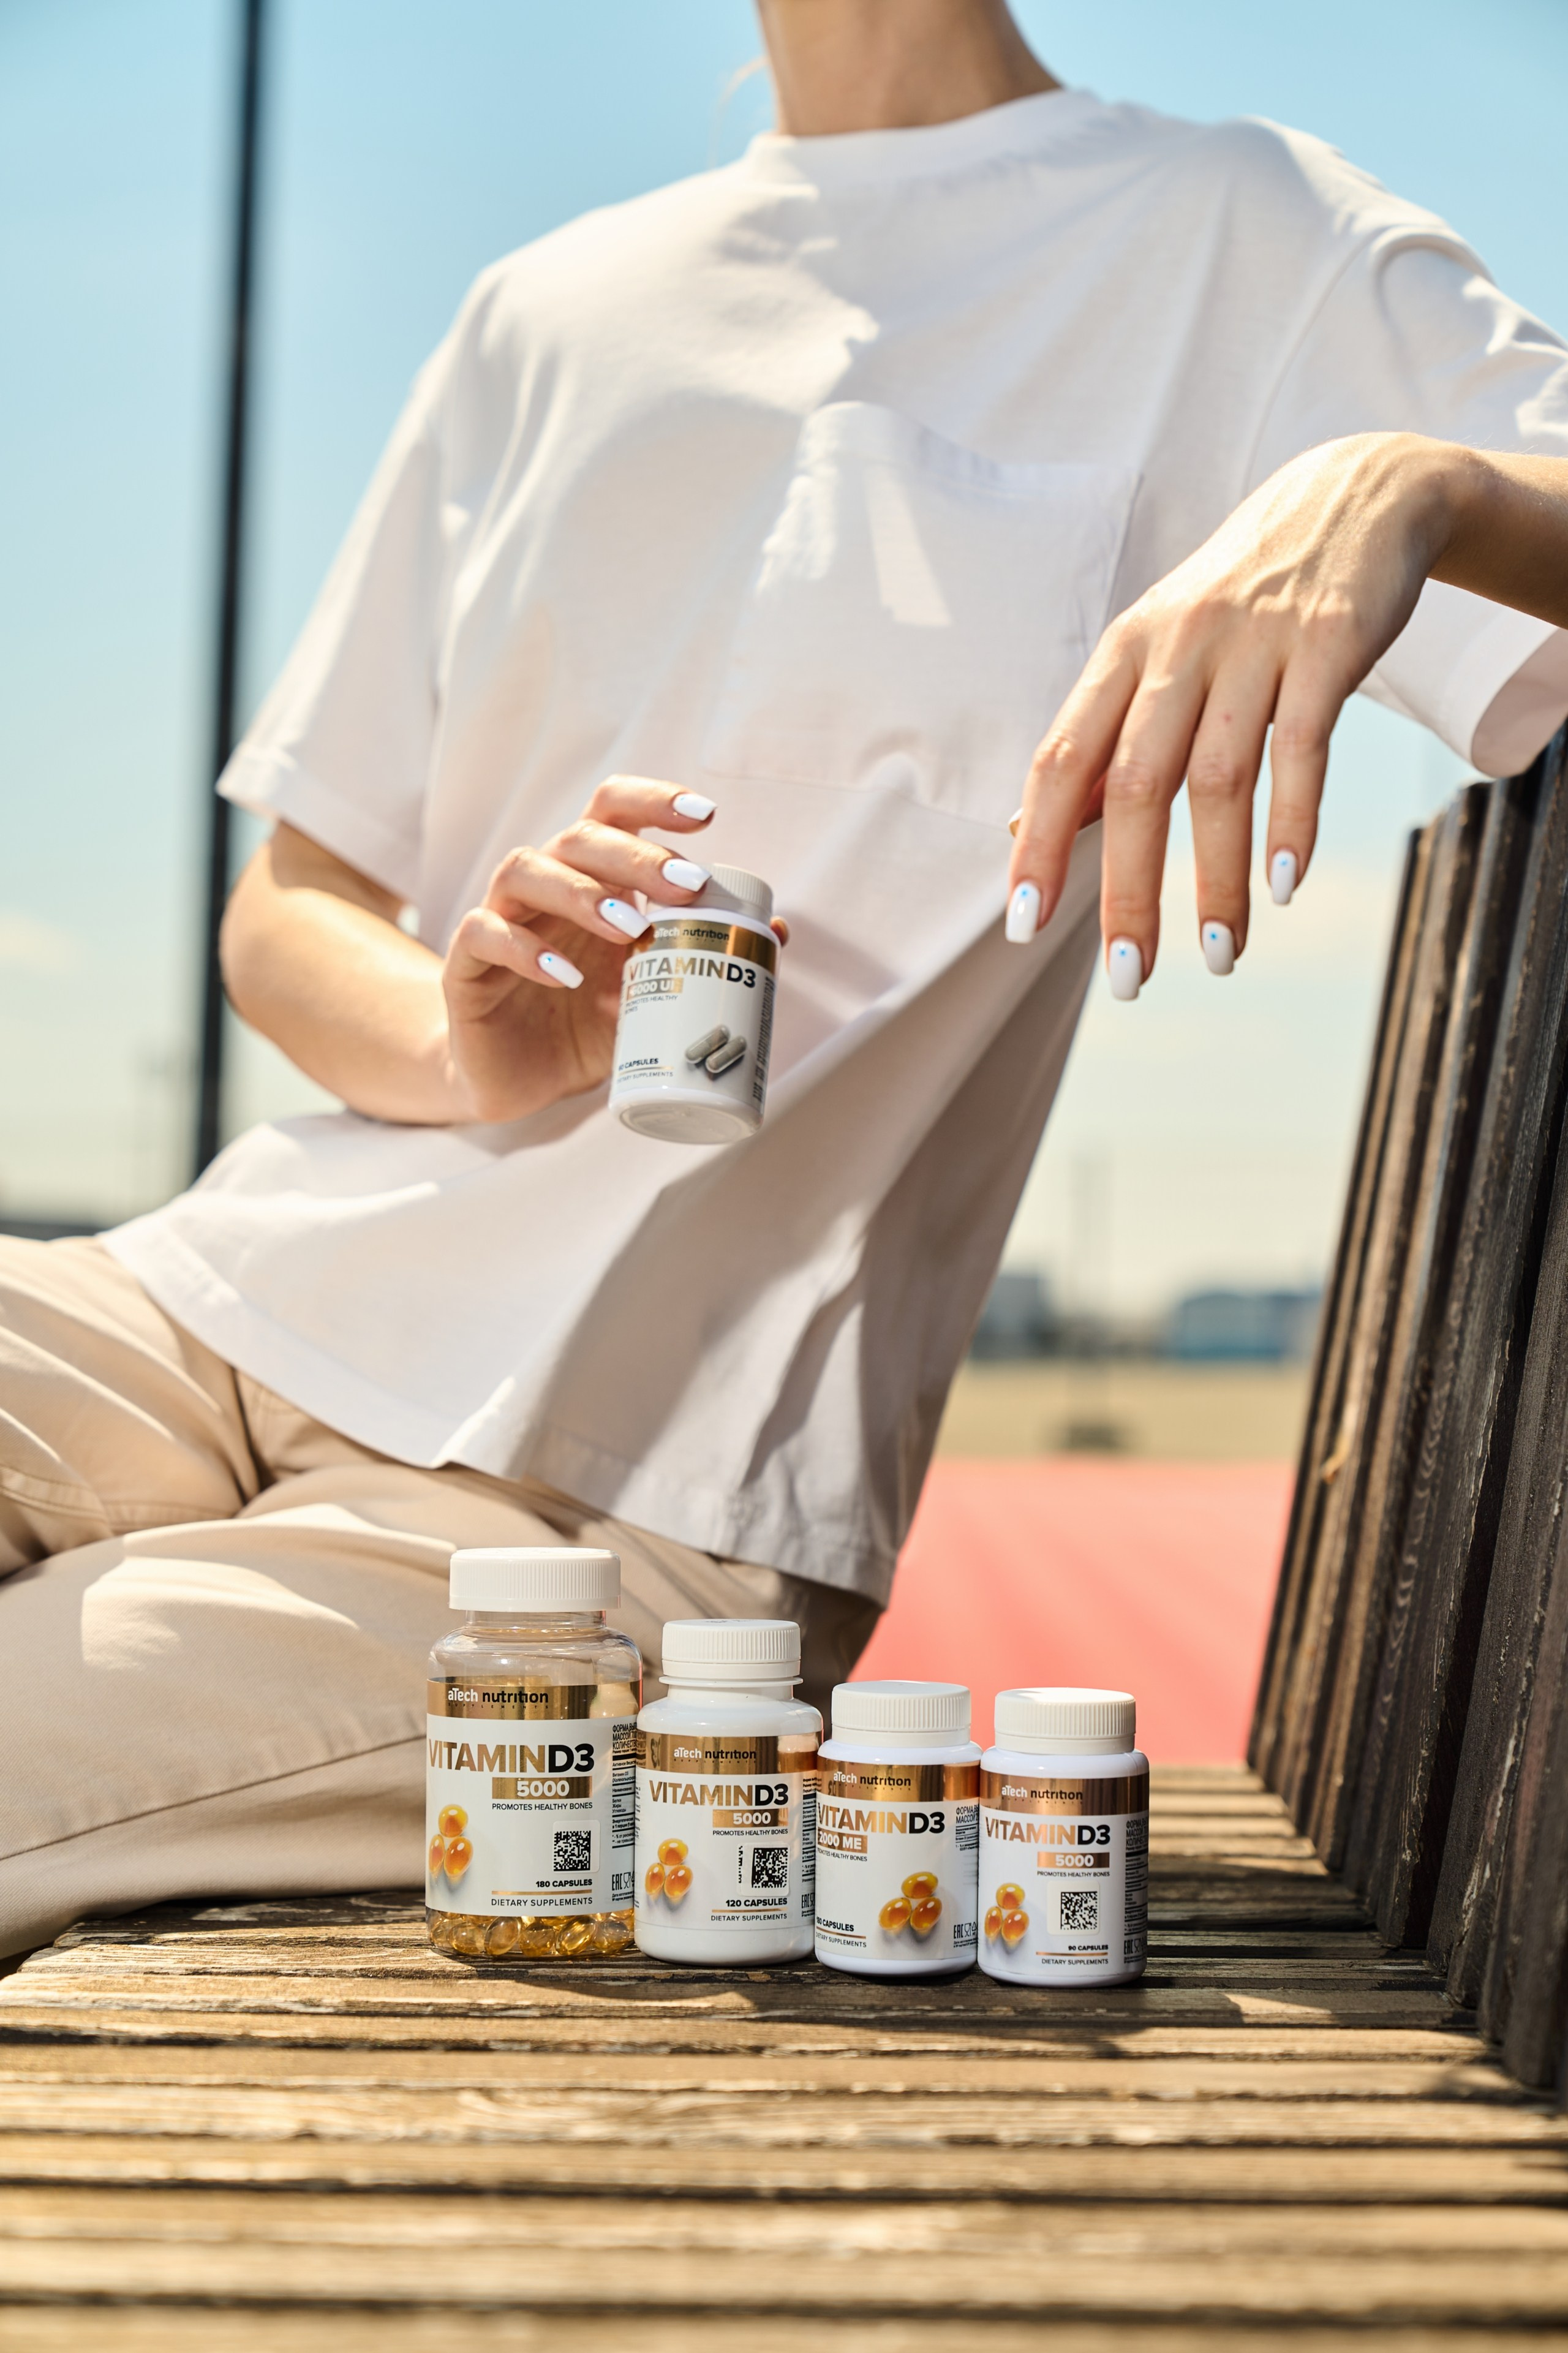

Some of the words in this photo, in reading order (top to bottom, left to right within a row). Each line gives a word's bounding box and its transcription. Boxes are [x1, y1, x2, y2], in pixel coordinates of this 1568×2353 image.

[654, 927, 680, 939] aTech
[682, 928, 729, 941] nutrition
[625, 1058, 659, 1068] CAPSULES
[448, 1688, 478, 1702] aTech
[482, 1691, 549, 1703] nutrition
[674, 1747, 702, 1759] aTech
[705, 1750, 756, 1759] nutrition
[833, 1771, 858, 1783] aTech
[860, 1776, 911, 1786] nutrition
[517, 1780, 570, 1797] 5000
[1001, 1785, 1028, 1798] aTech
[1030, 1789, 1083, 1800] nutrition
[733, 1812, 771, 1825] 5000
[819, 1830, 840, 1847] 2000
[1055, 1854, 1094, 1867] 5000
[552, 1879, 593, 1887] CAPSULES
[530, 1897, 593, 1906] SUPPLEMENTS
[744, 1898, 788, 1907] CAPSULES
[822, 1919, 854, 1932] CAPSULES
[829, 1936, 867, 1948] SUPPLEMENTS
